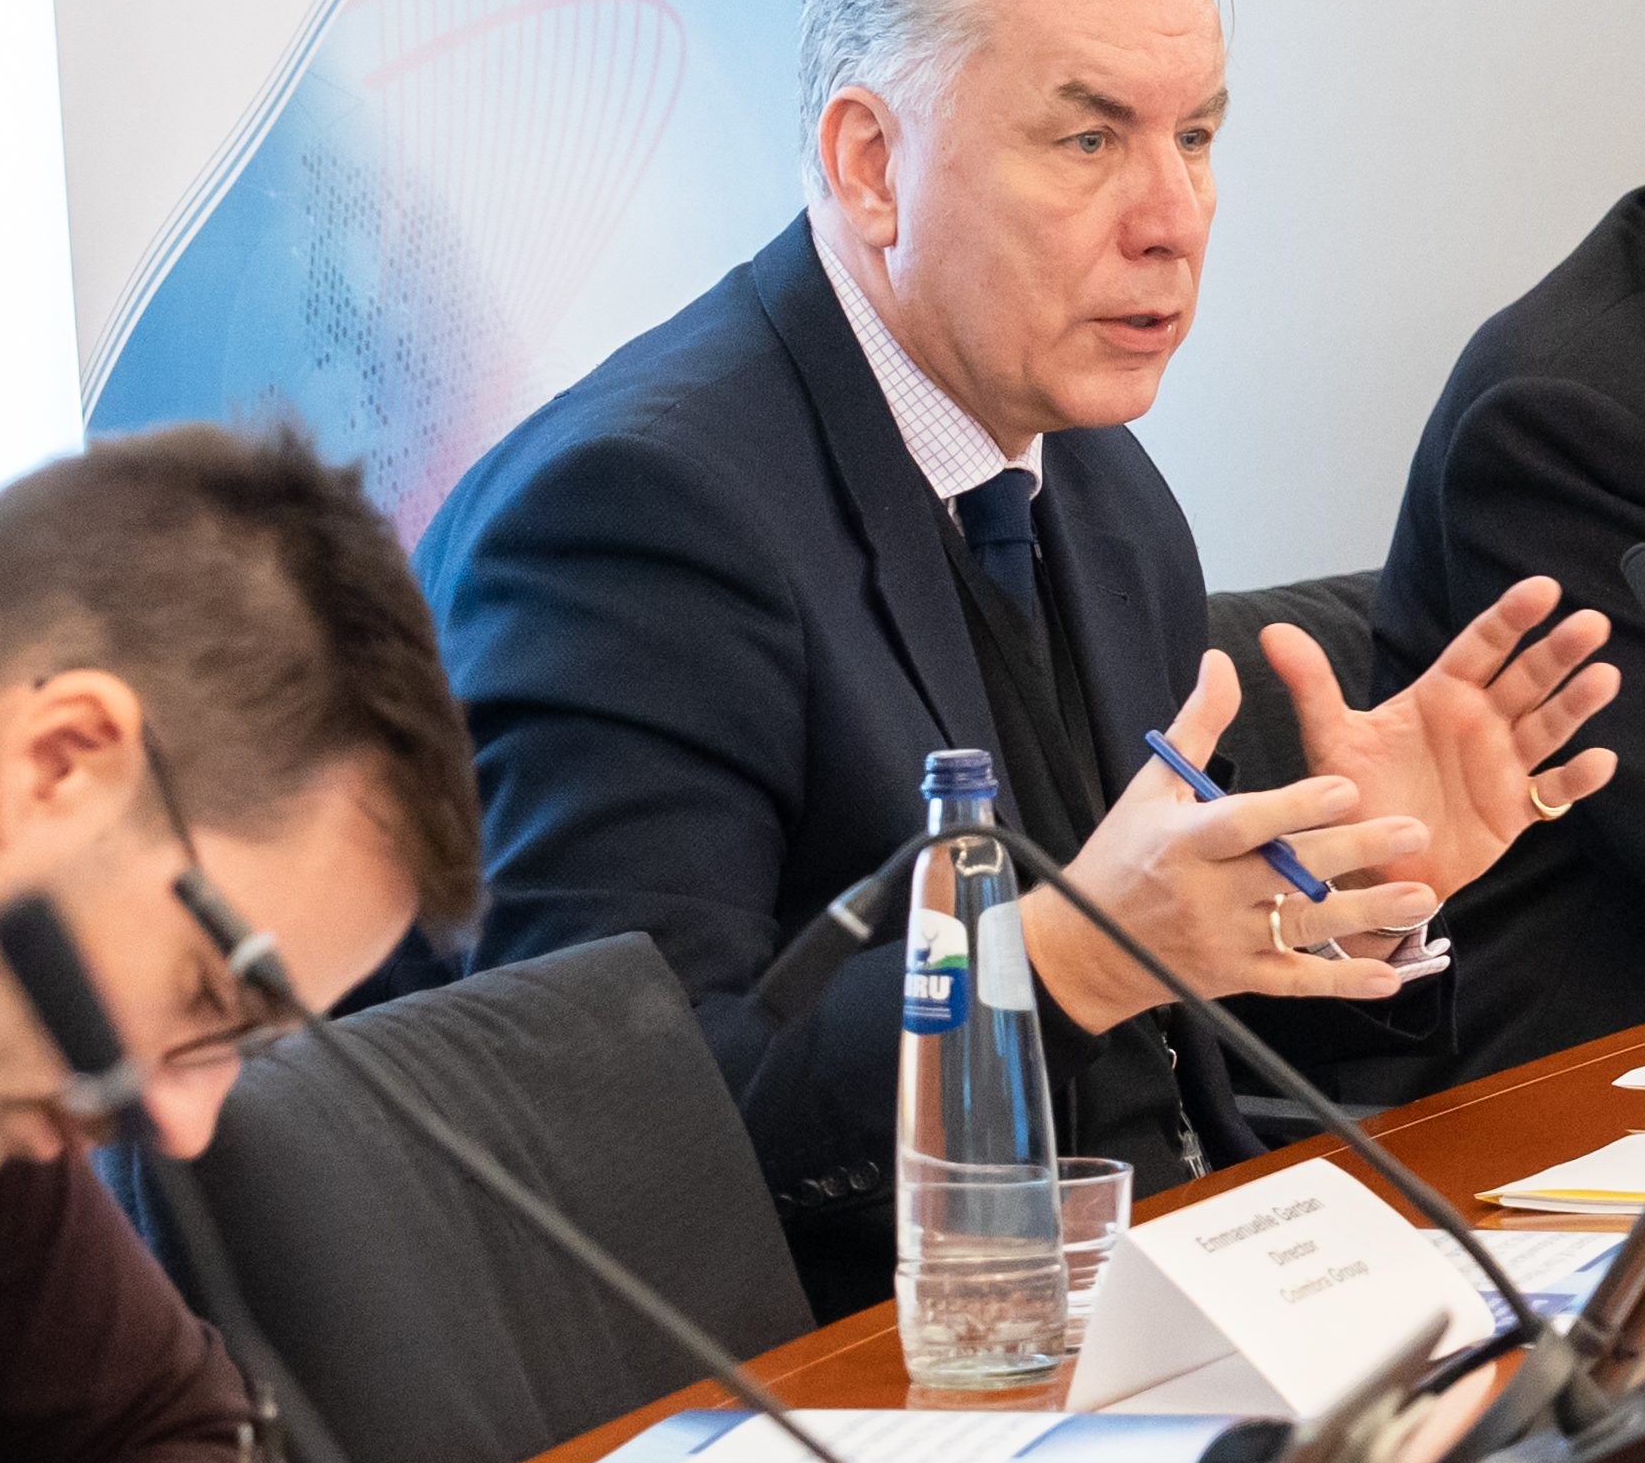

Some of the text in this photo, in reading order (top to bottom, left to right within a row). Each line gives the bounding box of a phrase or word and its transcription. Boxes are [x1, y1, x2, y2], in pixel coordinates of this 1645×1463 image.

[1195, 1198, 1326, 1254] Emmanuelle Gardan
[1267, 1240, 1319, 1266] Director
[1327, 1260, 1370, 1285] Group
